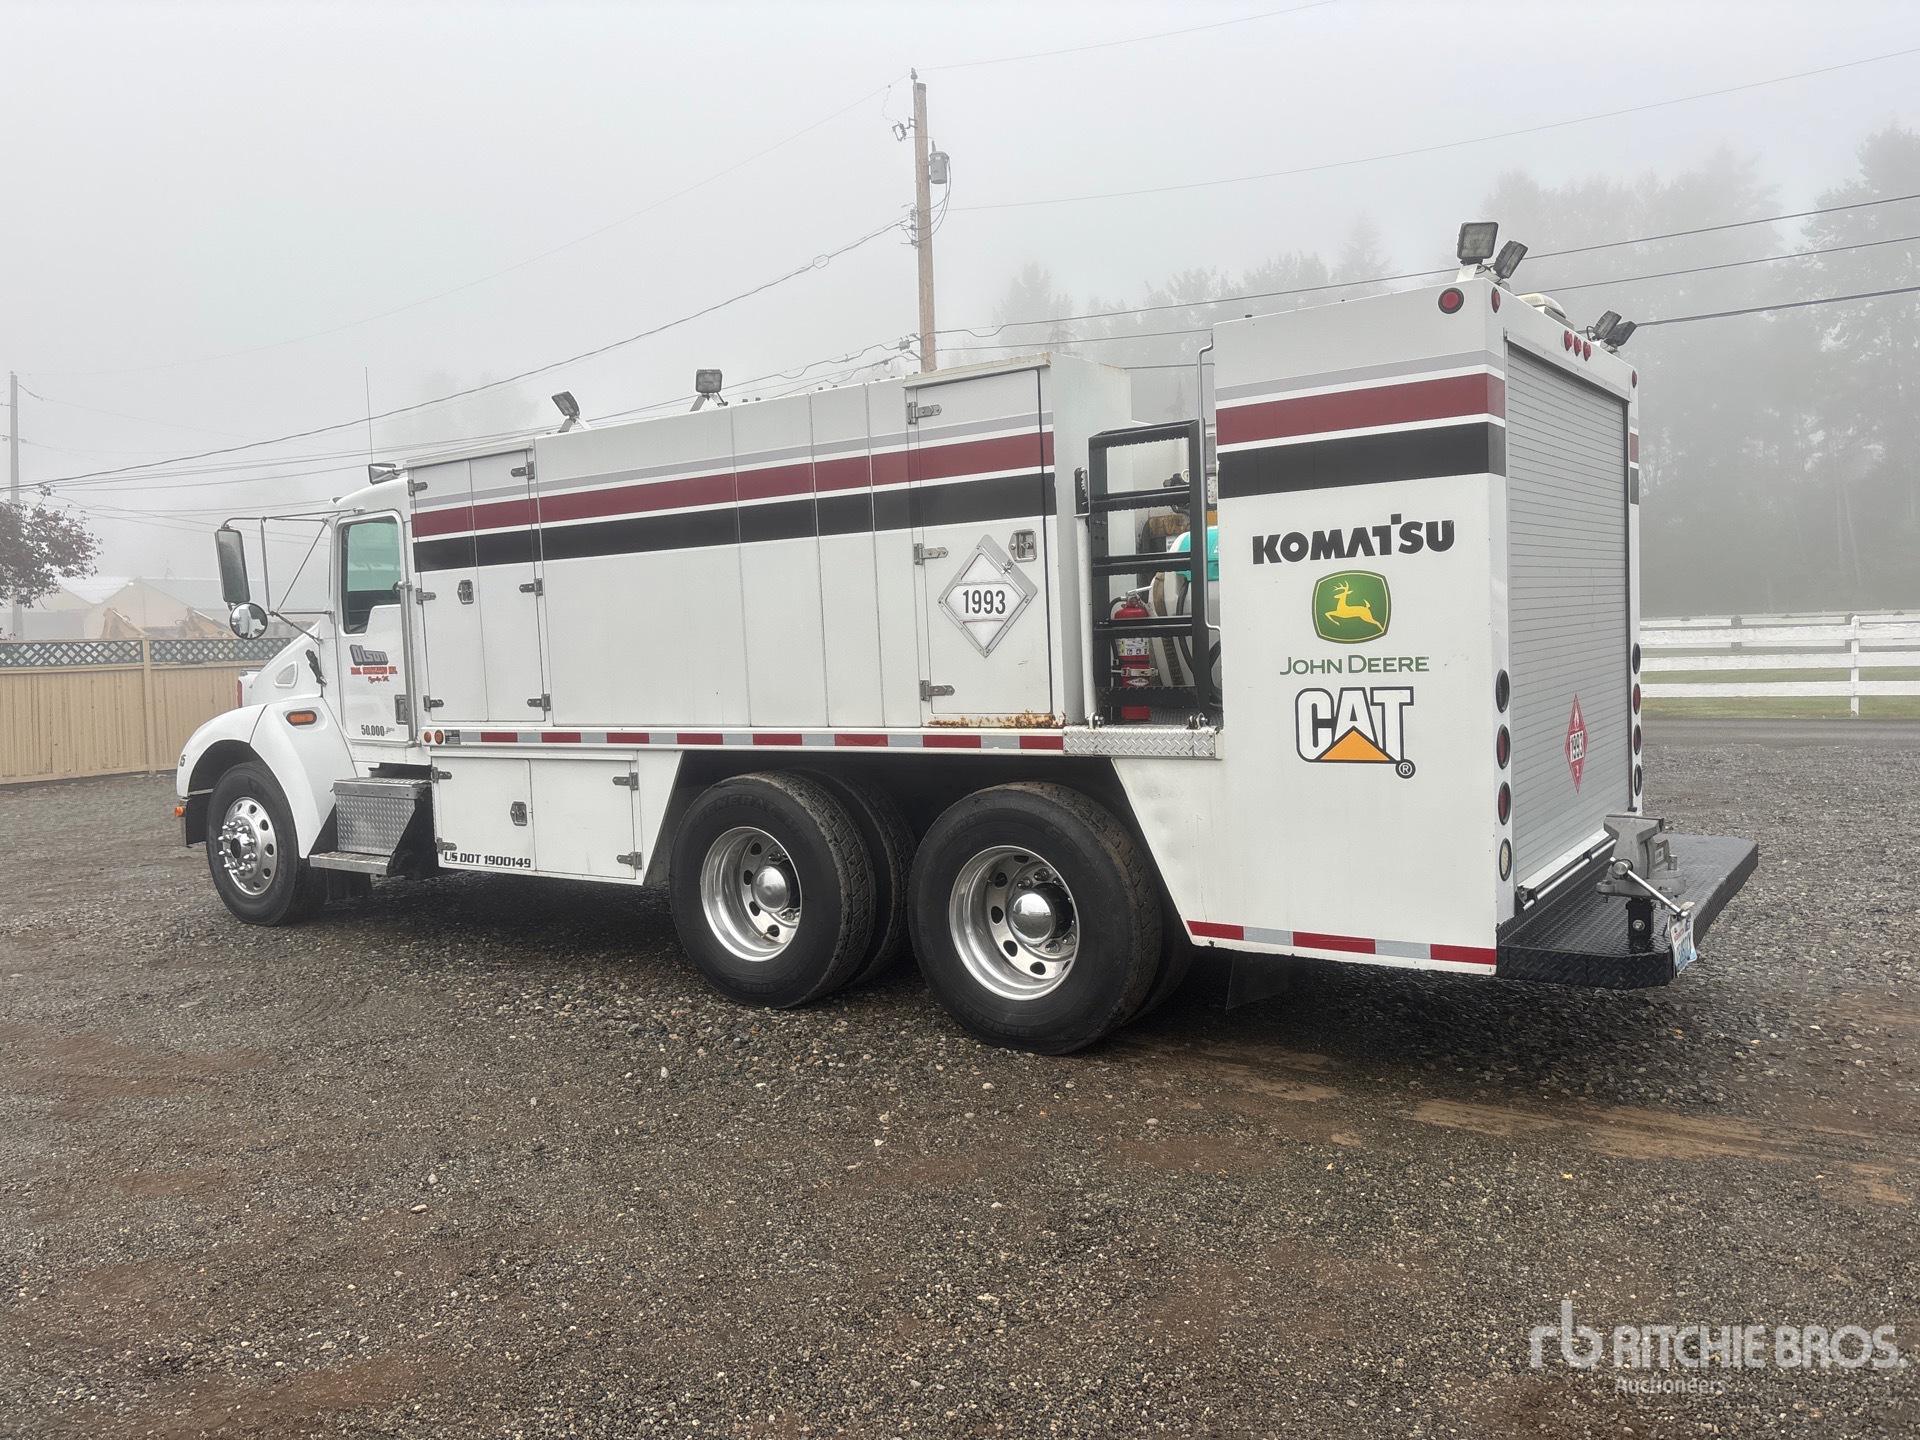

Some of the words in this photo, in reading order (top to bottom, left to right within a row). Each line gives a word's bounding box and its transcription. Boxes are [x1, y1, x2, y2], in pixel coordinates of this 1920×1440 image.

[1252, 513, 1455, 565] KOMATSU
[962, 589, 1006, 615] 1993
[1279, 656, 1343, 675] JOHN
[1348, 654, 1430, 674] DEERE
[1295, 686, 1415, 764] CAT
[444, 851, 458, 862] US
[460, 853, 481, 864] DOT
[484, 854, 531, 868] 1900149
